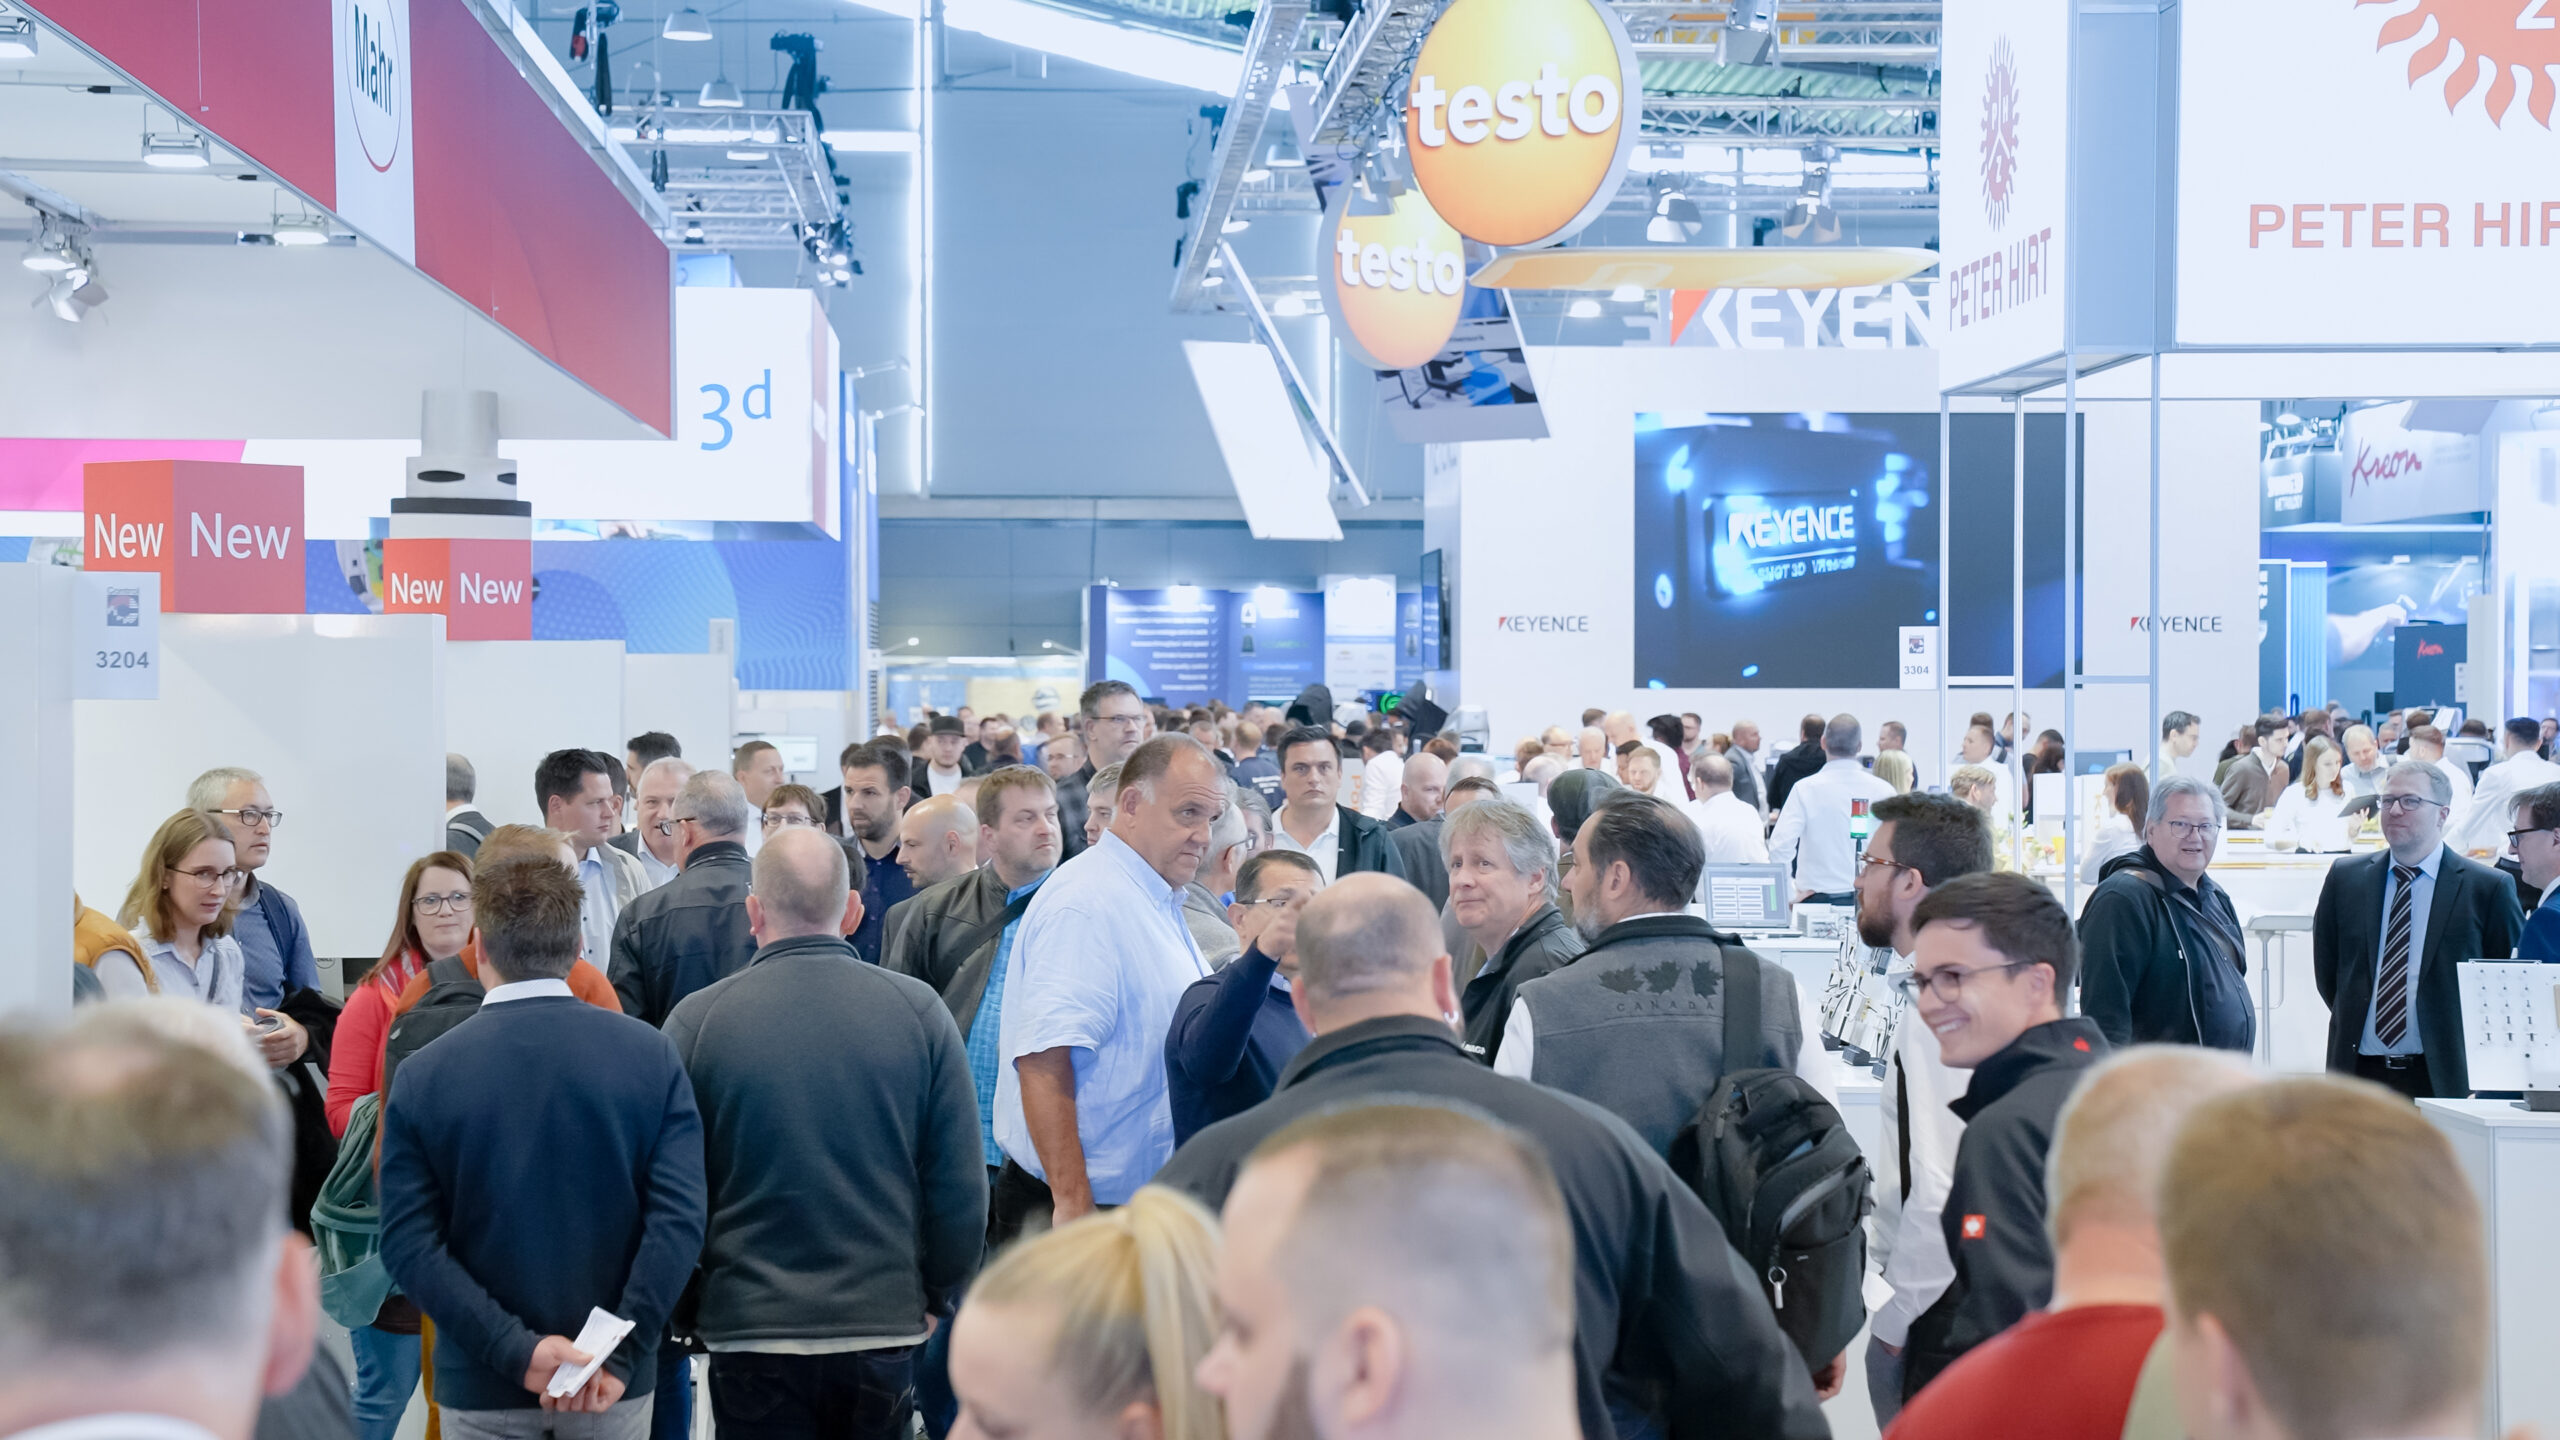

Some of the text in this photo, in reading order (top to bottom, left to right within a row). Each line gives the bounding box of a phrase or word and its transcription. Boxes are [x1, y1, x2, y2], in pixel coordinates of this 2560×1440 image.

[355, 4, 393, 116] Mahr
[1412, 62, 1619, 147] testo
[2249, 203, 2450, 248] PETER
[1337, 229, 1464, 295] testo
[1950, 227, 2051, 332] PETER HIRT
[2350, 437, 2422, 498] Kreon
[95, 513, 164, 560] New
[191, 512, 291, 560] New
[1728, 505, 1855, 549] KEYENCE
[391, 572, 443, 604] New
[460, 572, 523, 604] New
[1498, 616, 1588, 632] KEYENCE
[96, 650, 149, 669] 3204
[1904, 665, 1929, 675] 3304
[1616, 1001, 1715, 1012] CANADA
